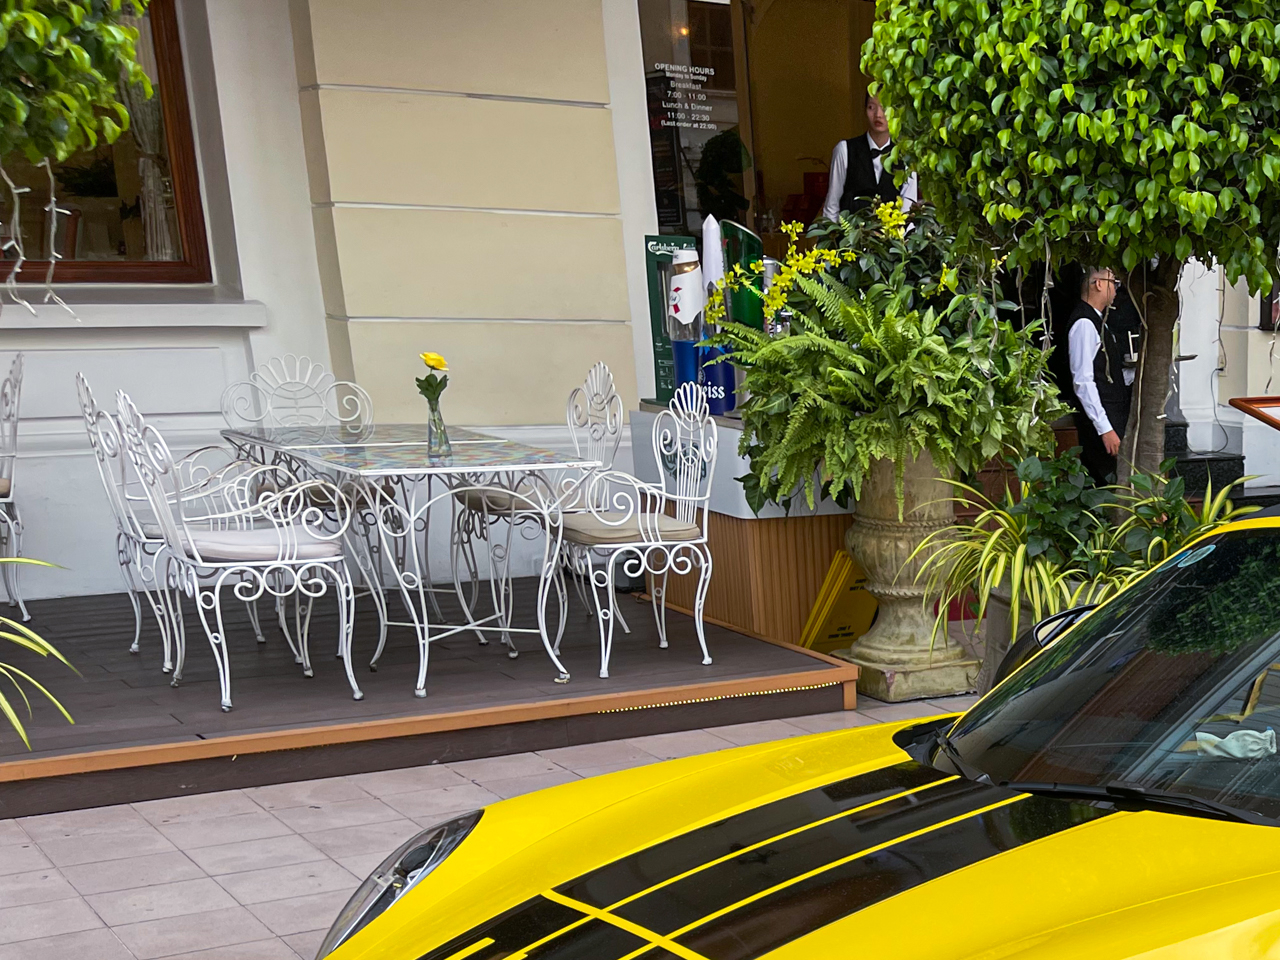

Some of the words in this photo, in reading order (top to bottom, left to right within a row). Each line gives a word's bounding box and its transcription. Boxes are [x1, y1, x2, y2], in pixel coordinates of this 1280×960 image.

[654, 62, 688, 73] OPENING
[688, 66, 715, 76] HOURS
[670, 80, 702, 90] Breakfast
[661, 100, 683, 109] Lunch
[684, 102, 690, 110] &
[690, 103, 713, 111] Dinner
